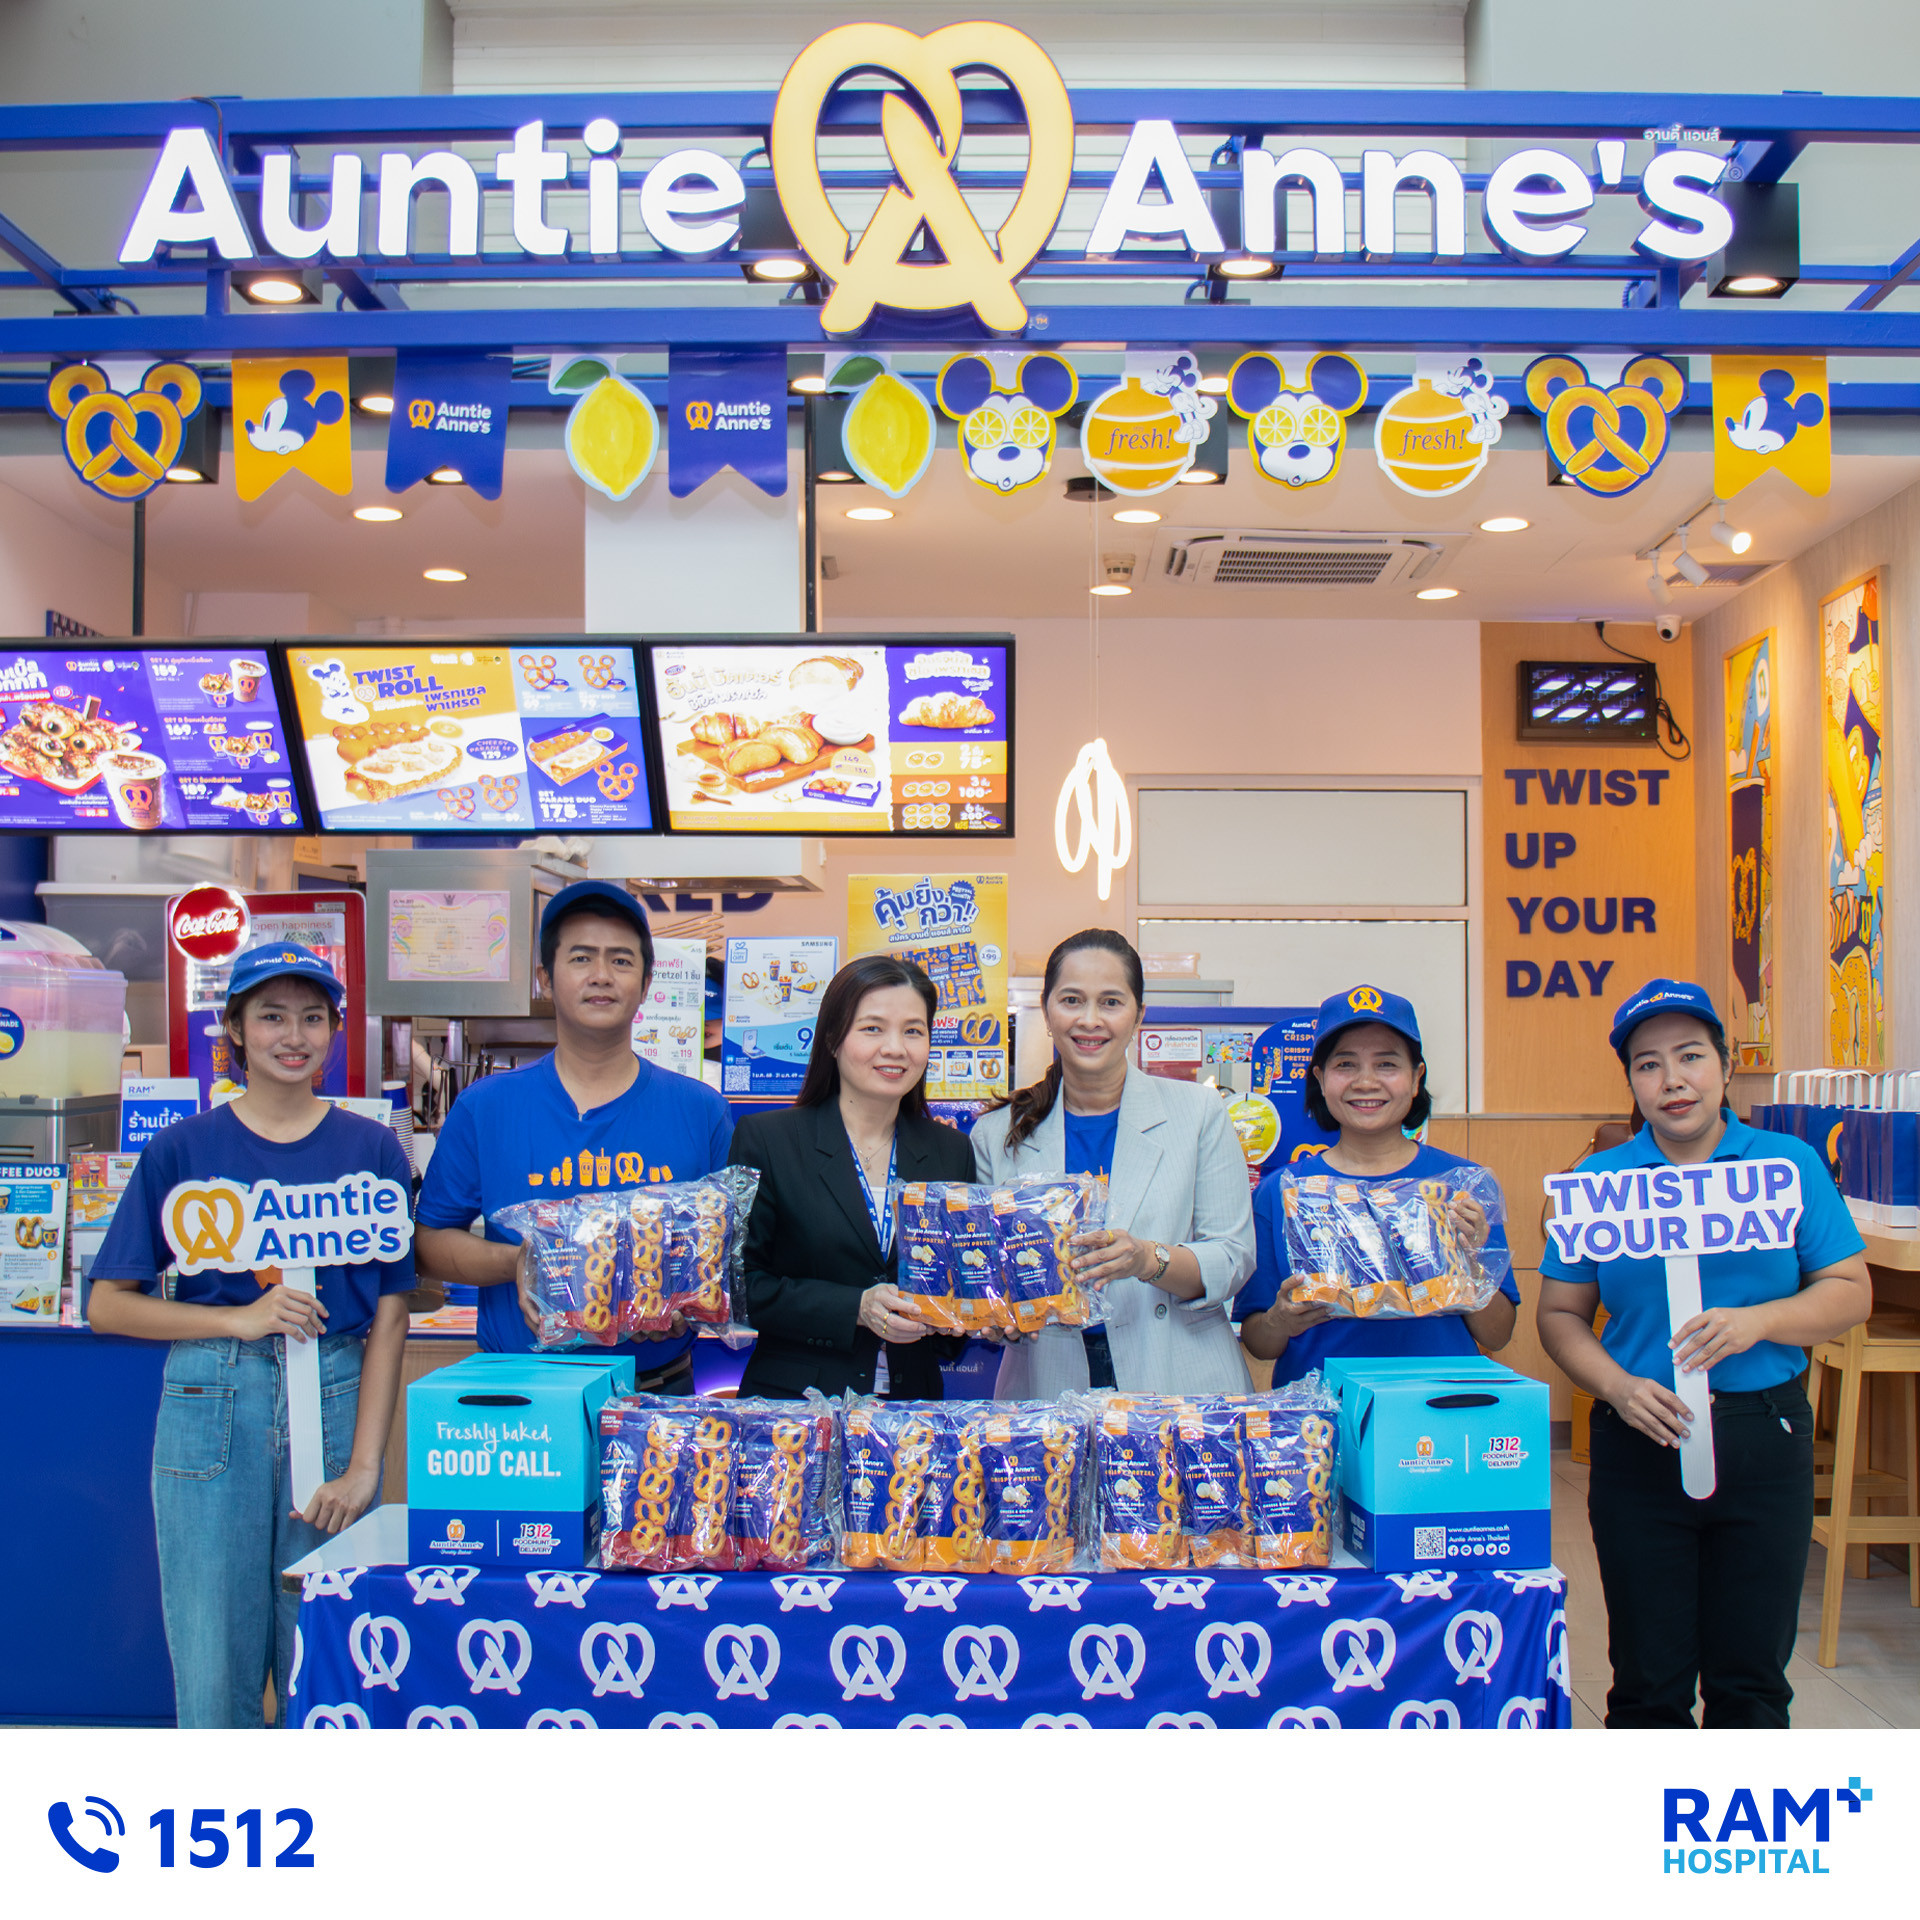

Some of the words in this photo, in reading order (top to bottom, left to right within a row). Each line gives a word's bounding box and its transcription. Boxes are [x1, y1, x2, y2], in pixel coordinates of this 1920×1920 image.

[118, 118, 747, 263] Auntie
[1085, 118, 1736, 261] Anne's
[437, 402, 492, 419] Auntie
[715, 401, 771, 416] Auntie
[435, 417, 491, 434] Anne's
[715, 417, 771, 431] Anne's
[1104, 428, 1173, 456] fresh!
[1398, 428, 1465, 457] fresh!
[353, 665, 416, 685] TWIST
[378, 676, 444, 699] ROLL
[1504, 769, 1670, 807] TWIST
[1505, 832, 1577, 869] UP
[254, 921, 279, 931] open
[282, 919, 333, 930] happiness
[1507, 897, 1657, 934] YOUR
[653, 971, 682, 980] Pretzel
[1506, 960, 1614, 999] DAY
[644, 1048, 658, 1057] 109
[680, 1049, 692, 1058] 119
[128, 1107, 184, 1128] ร้านนี้รั
[128, 1133, 154, 1142] GIFT
[25, 1167, 61, 1177] DUOS
[253, 1179, 399, 1222] Auntie
[1550, 1168, 1712, 1217] TWIST
[1725, 1164, 1794, 1202] UP
[255, 1222, 401, 1262] Anne's
[1553, 1215, 1690, 1258] YOUR
[1702, 1207, 1797, 1249] DAY
[436, 1421, 498, 1454] Freshly
[1489, 1437, 1519, 1451] 1312
[428, 1450, 491, 1477] GOOD
[500, 1450, 561, 1477] CALL.
[521, 1524, 552, 1538] 1312
[1487, 1533, 1510, 1541] Thailand
